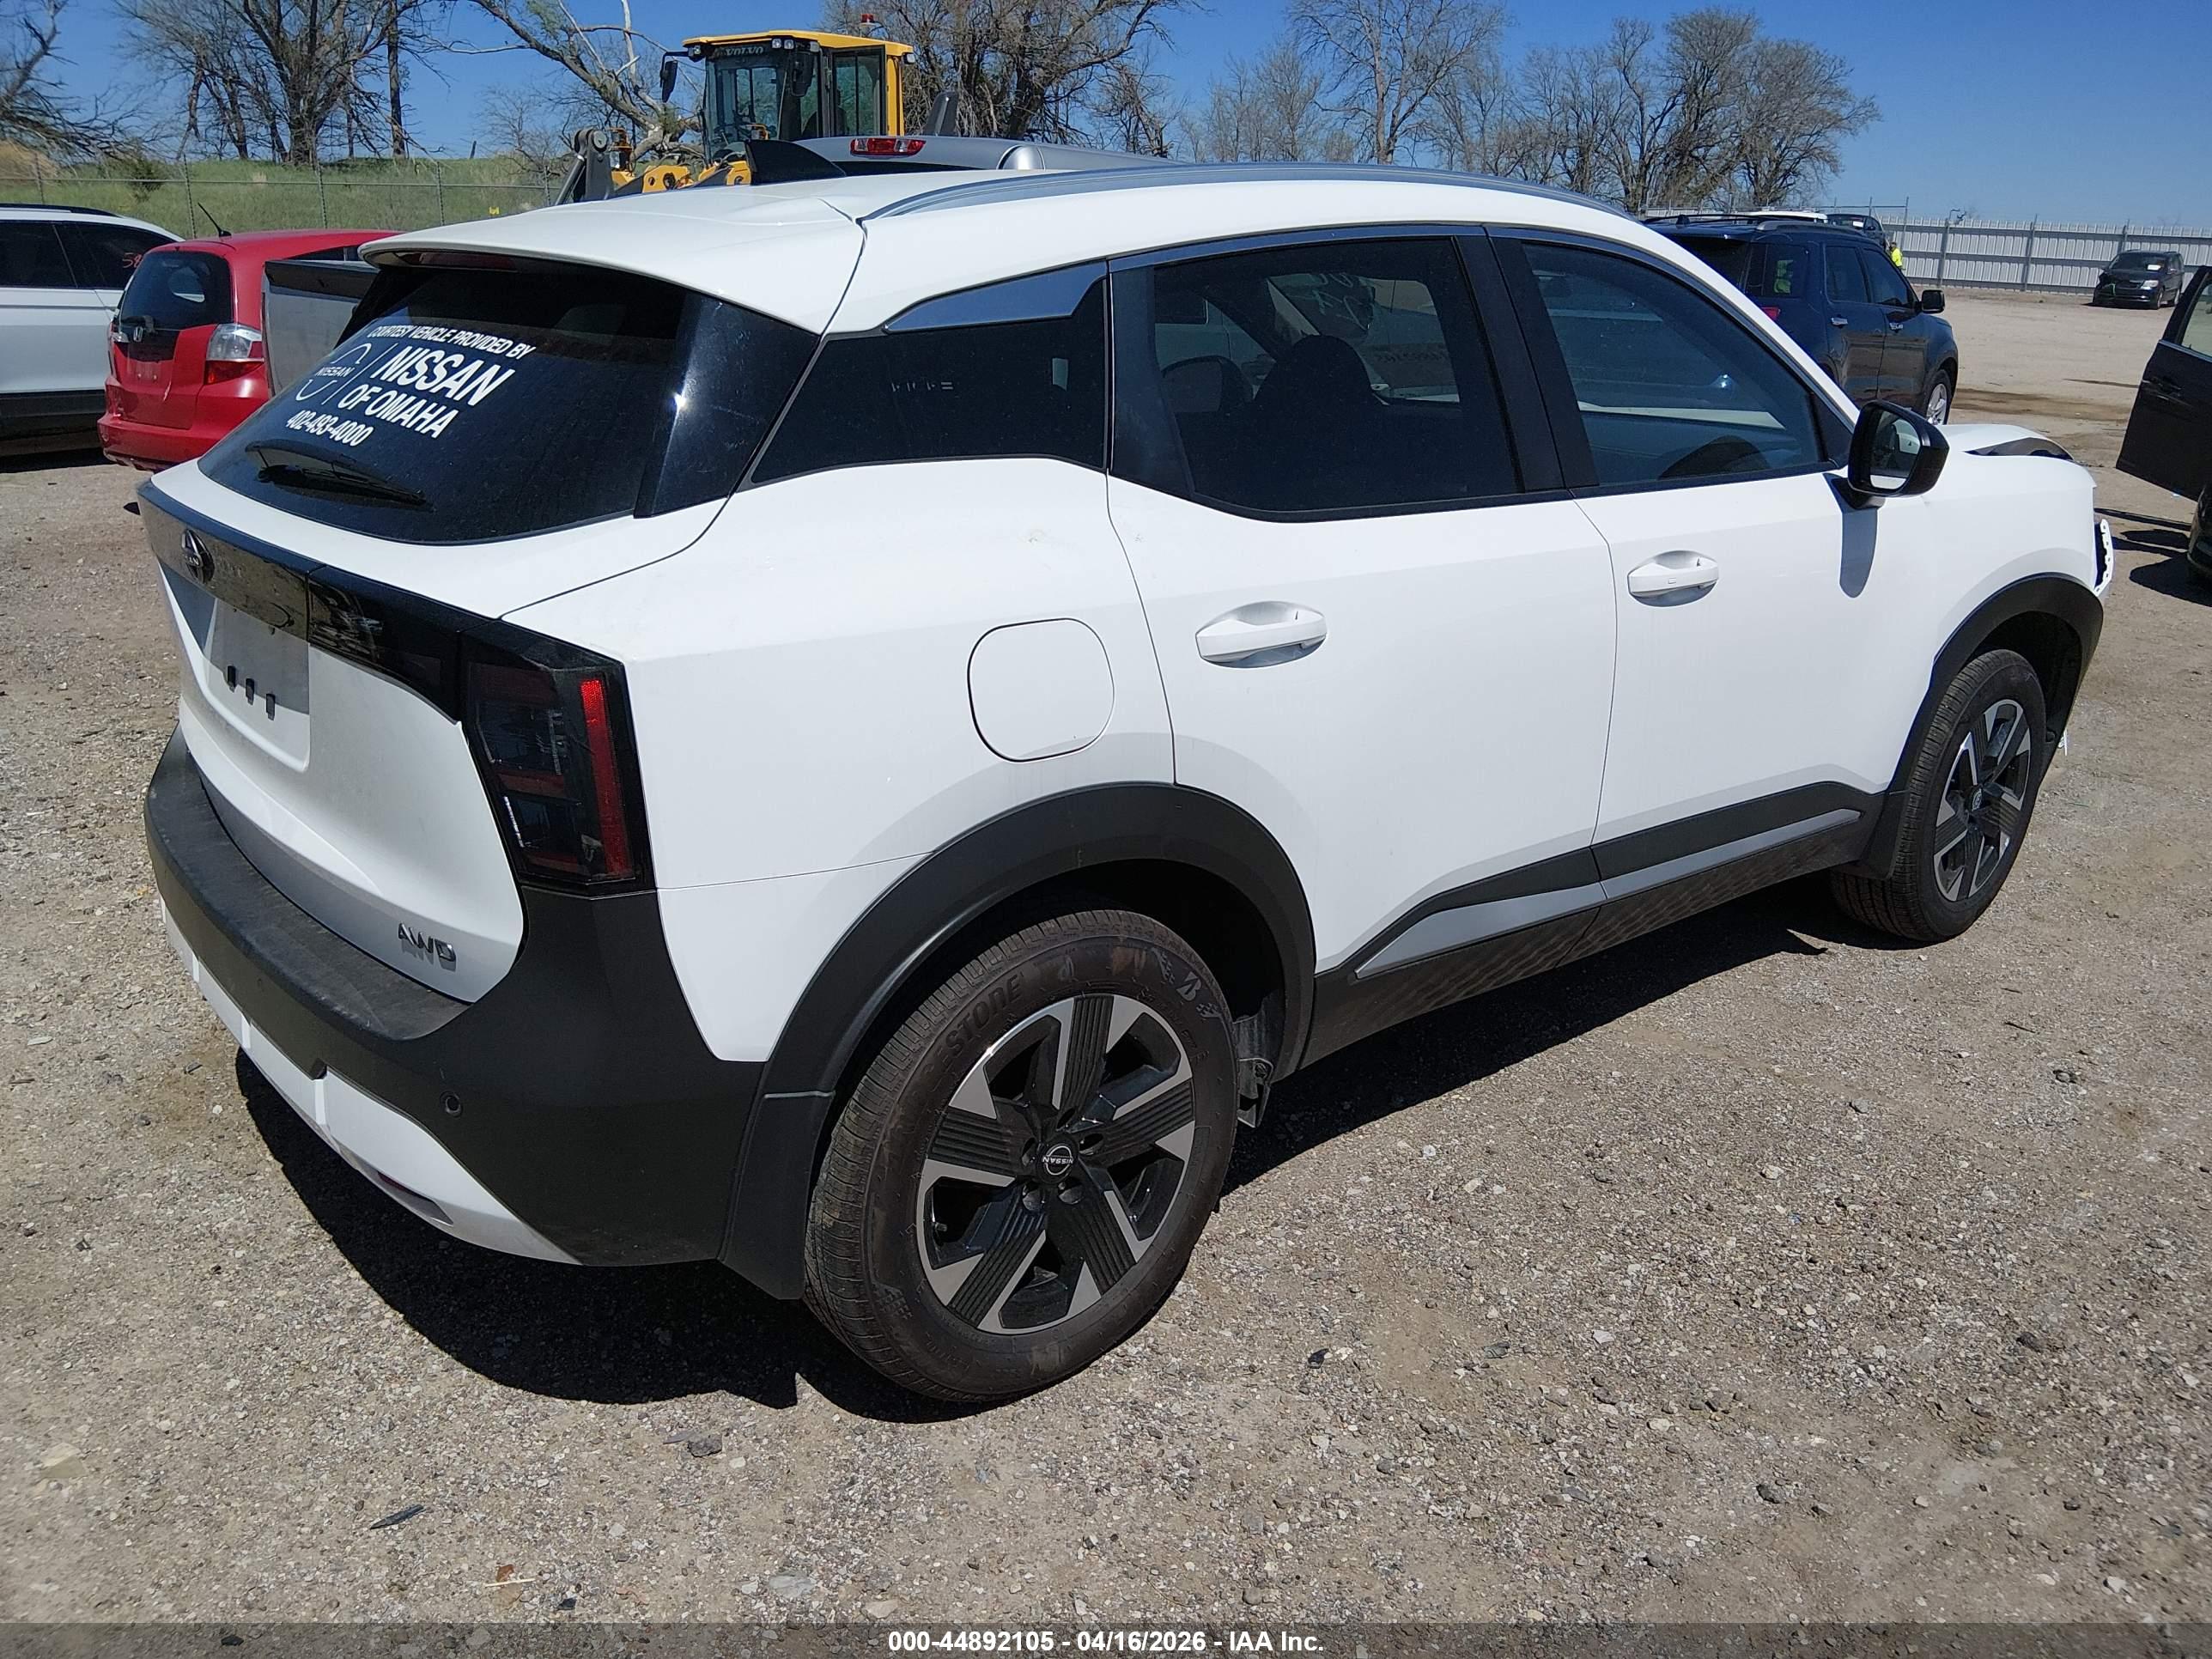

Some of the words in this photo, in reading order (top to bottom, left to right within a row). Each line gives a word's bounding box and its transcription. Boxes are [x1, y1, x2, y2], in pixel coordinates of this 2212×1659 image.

[367, 325, 415, 338] COURTESY
[408, 325, 456, 343] VEHICLE
[447, 330, 514, 355] PROVIDED
[505, 343, 537, 360] BY
[314, 366, 356, 378] NISSAN
[370, 345, 515, 407] NISSAN
[285, 410, 374, 447] 402-493-4000
[337, 383, 375, 410] OF
[364, 389, 459, 439] OMAHA
[398, 922, 457, 963] AWD
[1042, 1156, 1073, 1164] NISSAN
